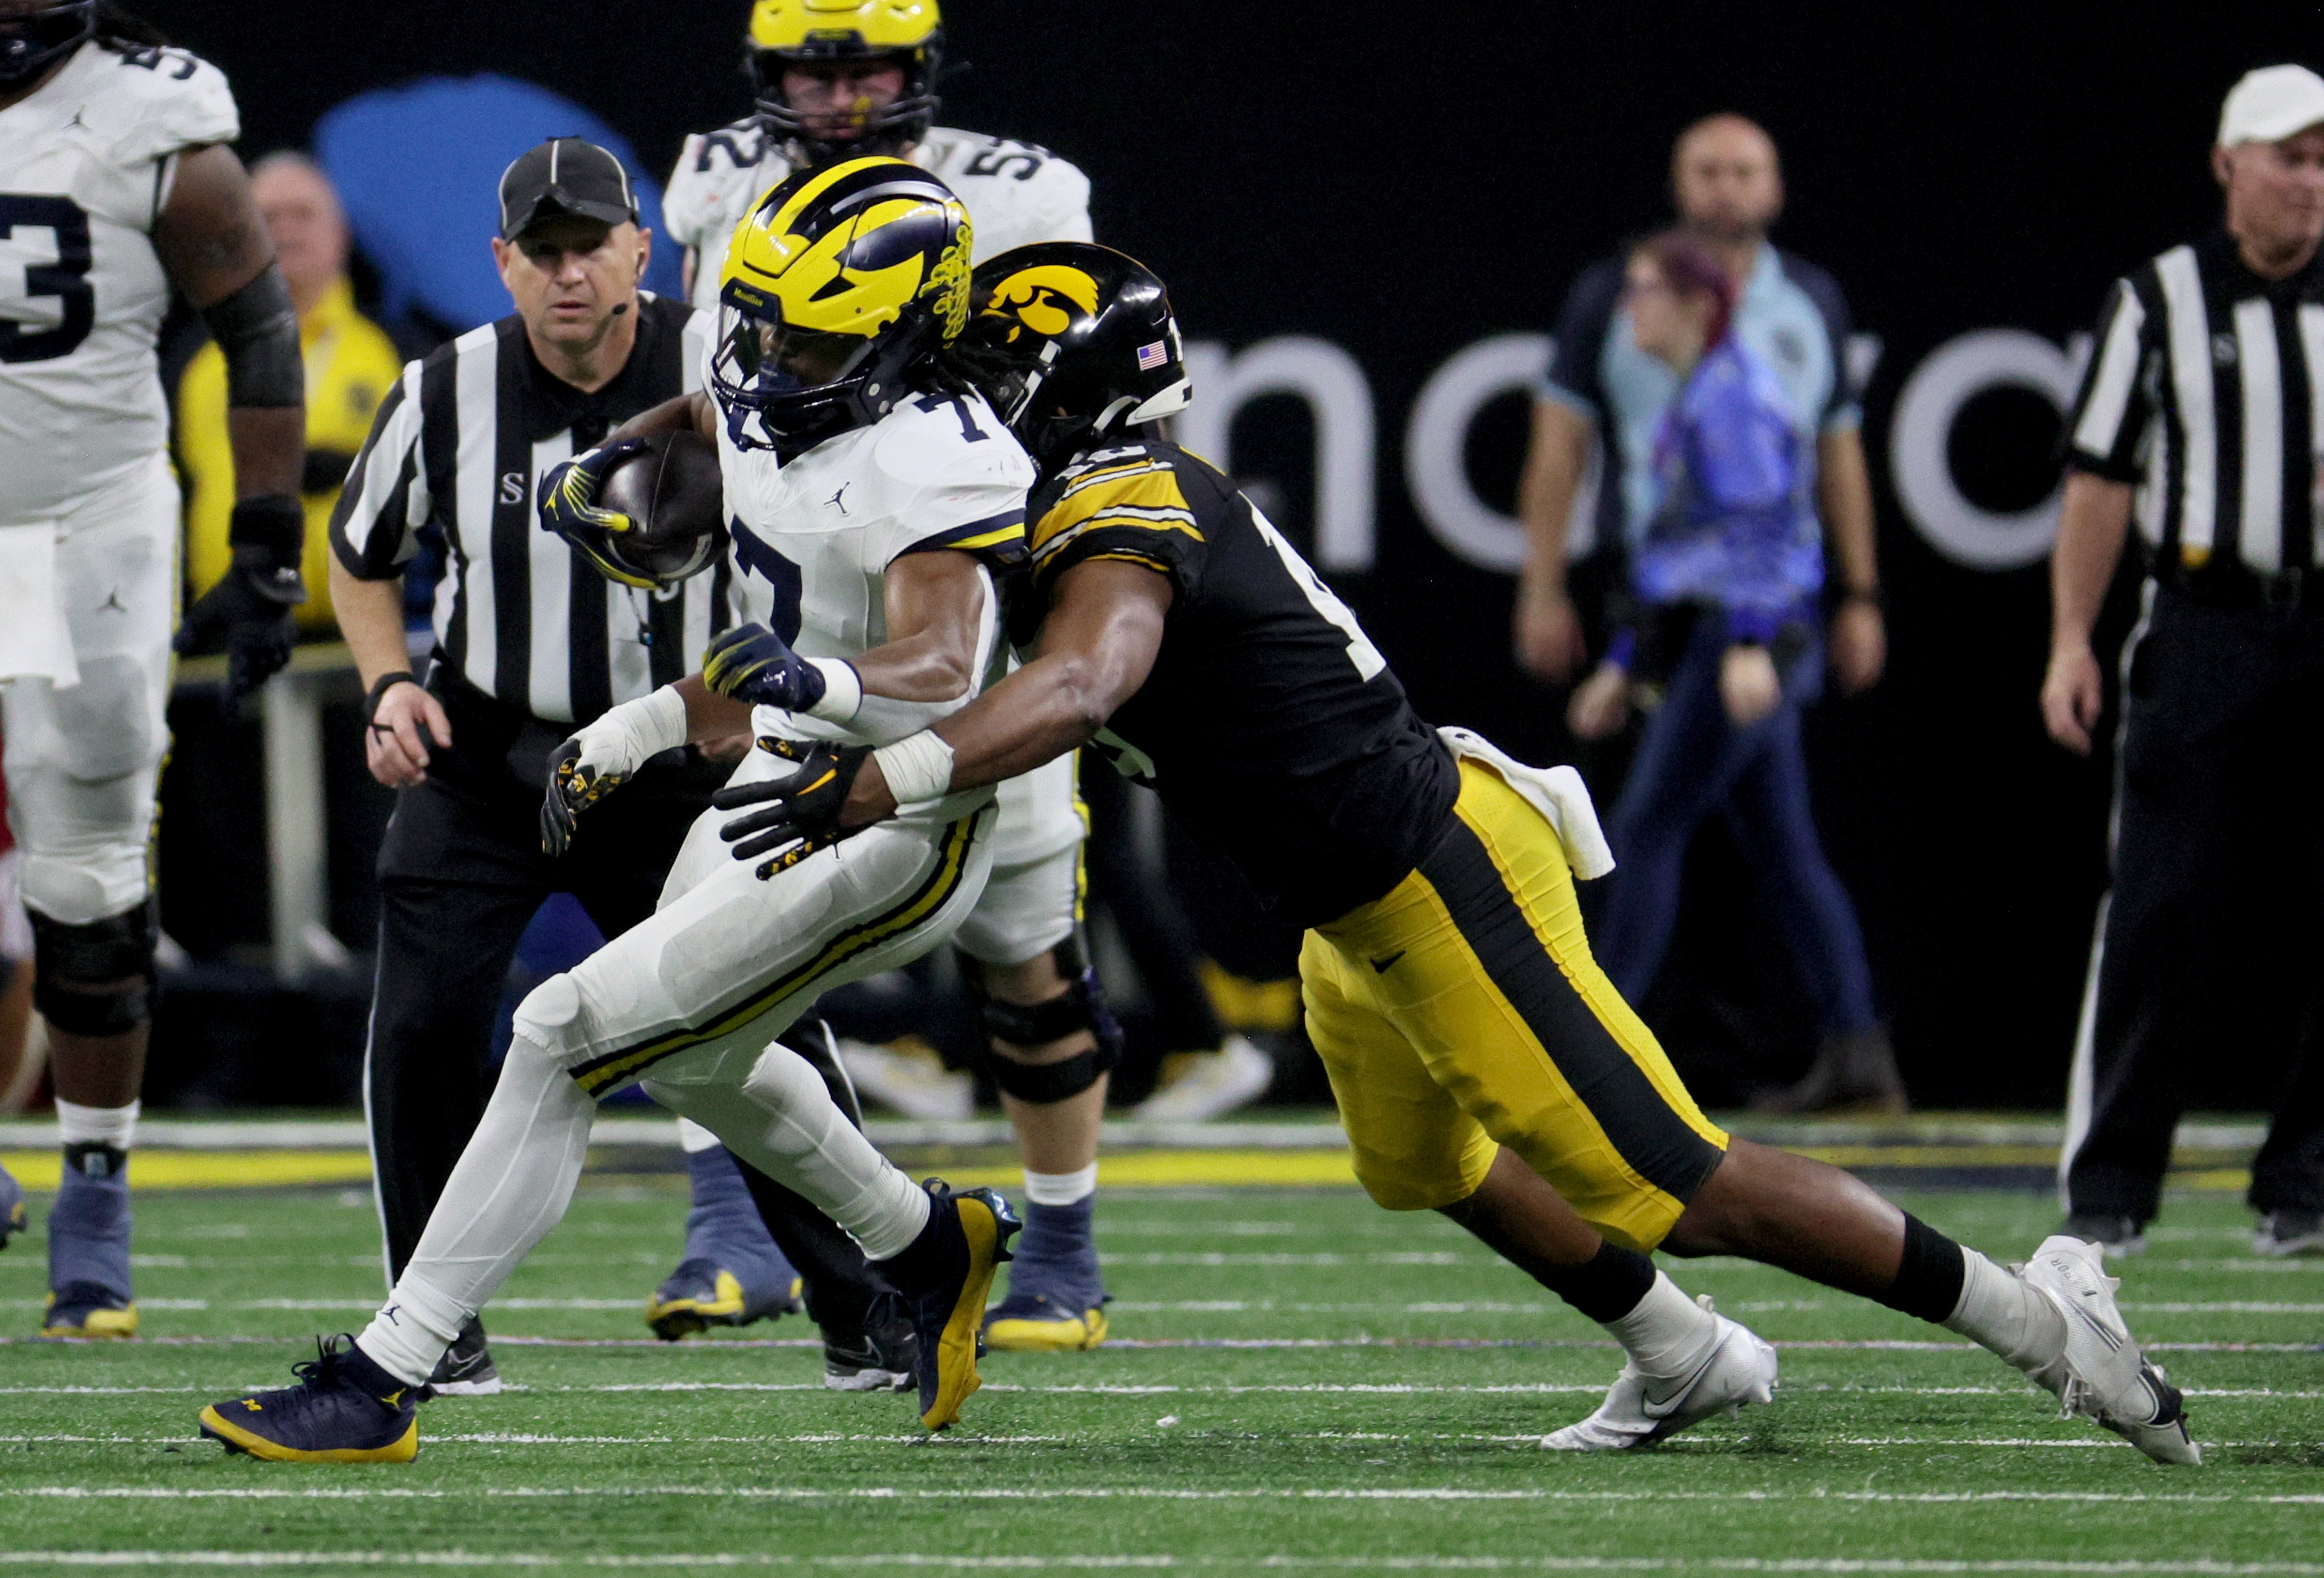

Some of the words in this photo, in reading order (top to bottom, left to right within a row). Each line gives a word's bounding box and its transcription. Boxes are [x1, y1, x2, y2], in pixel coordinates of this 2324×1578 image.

[963, 137, 1056, 181] 5
[912, 392, 991, 443] 7
[500, 472, 524, 504] S
